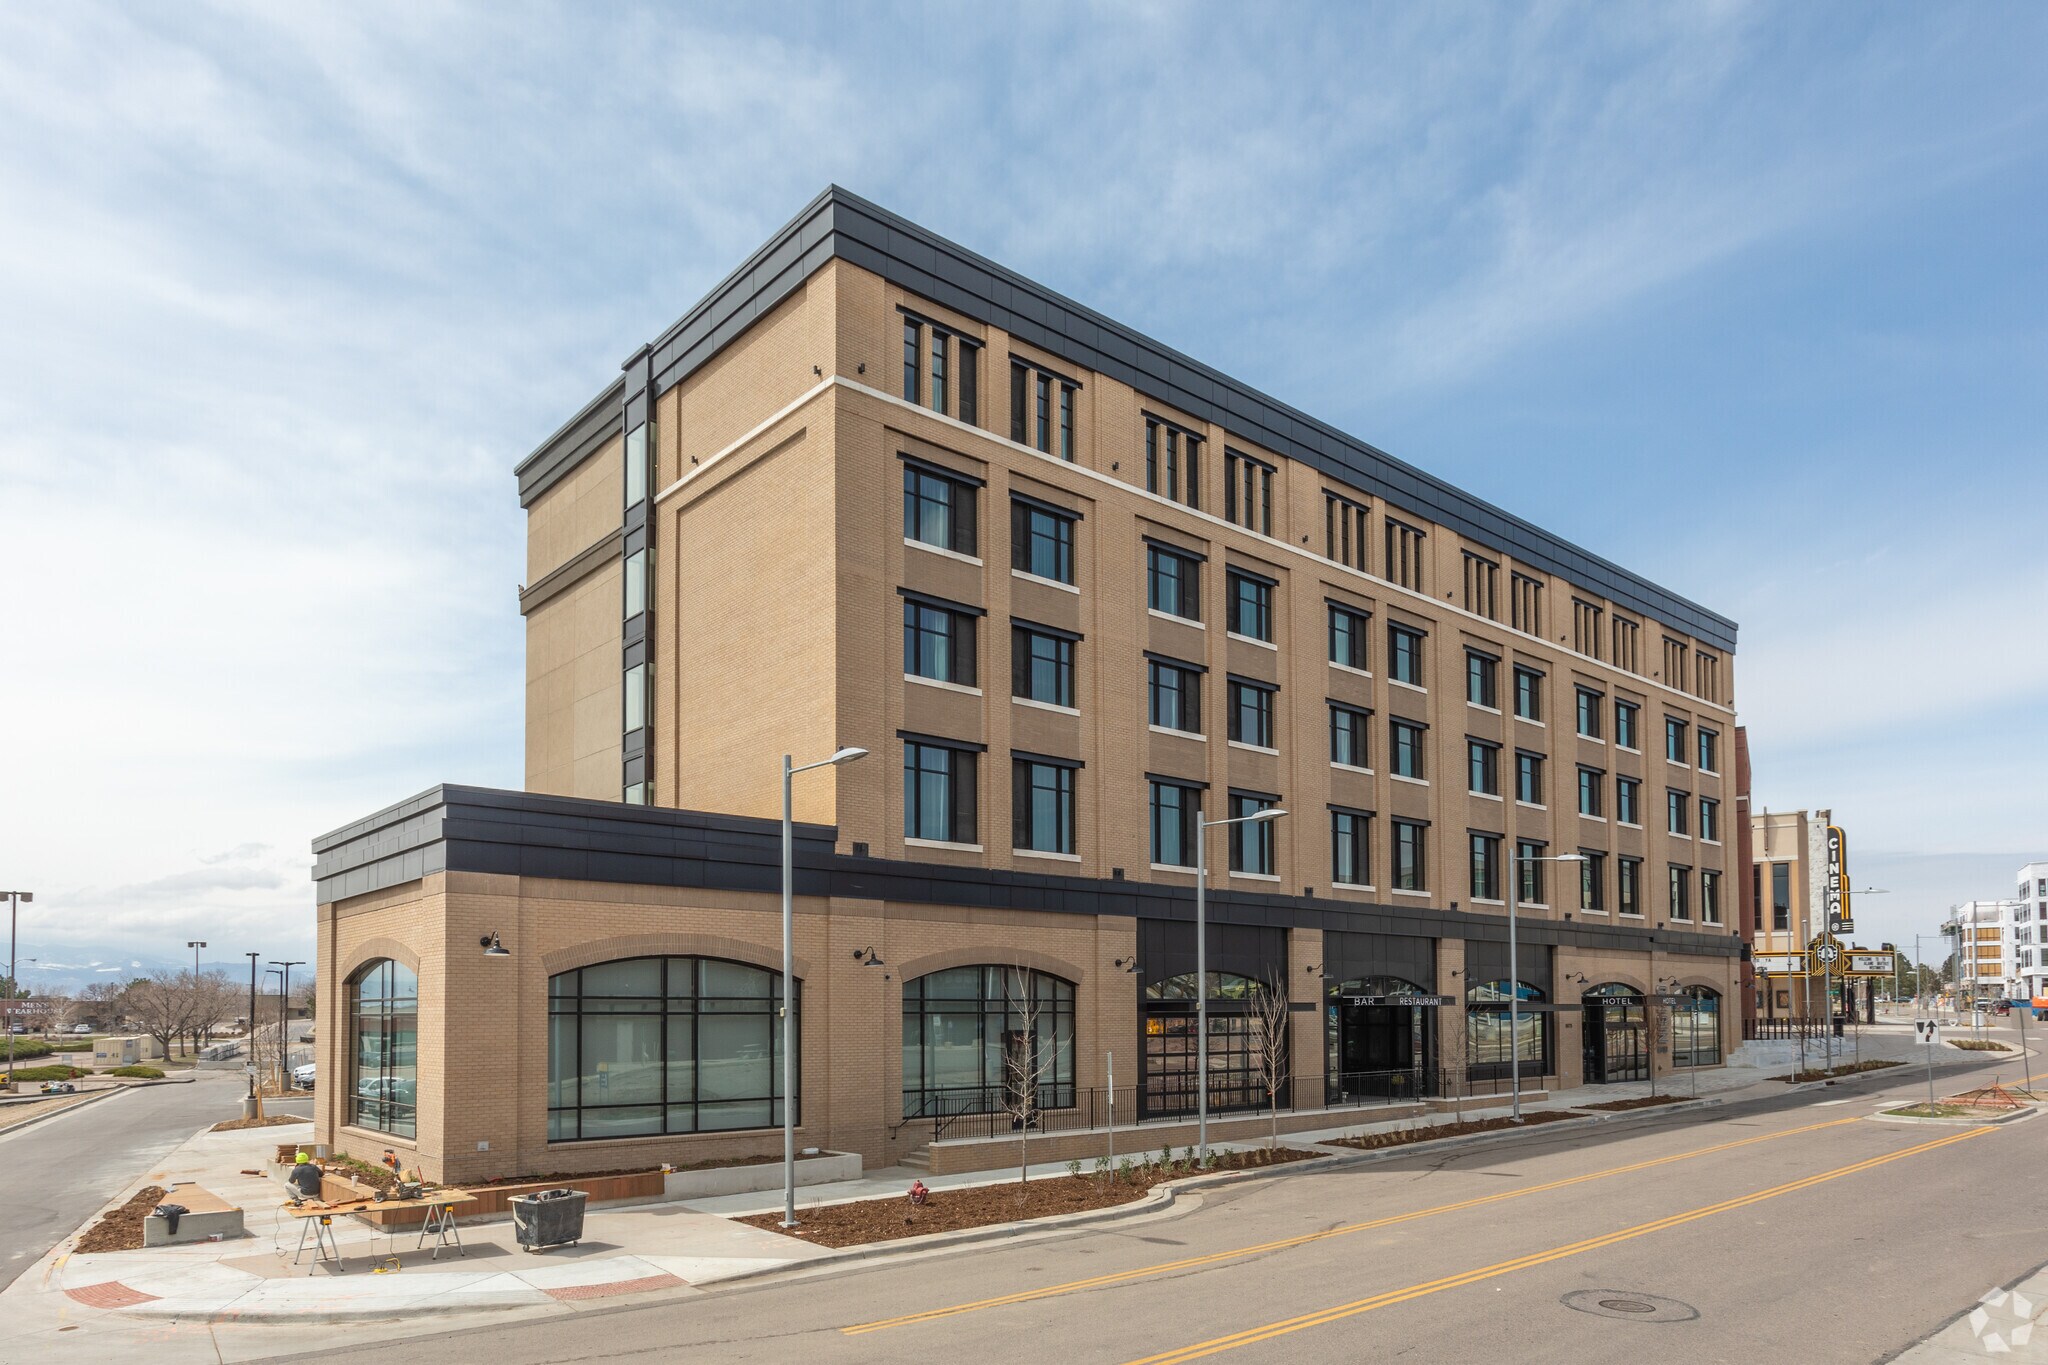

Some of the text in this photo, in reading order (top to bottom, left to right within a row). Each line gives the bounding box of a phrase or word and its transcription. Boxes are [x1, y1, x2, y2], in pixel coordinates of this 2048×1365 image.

[1828, 837, 1841, 914] CINEMA
[1354, 997, 1442, 1006] BAR RESTAURANT
[1602, 997, 1633, 1005] HOTEL
[1662, 997, 1677, 1005] HOTEL
